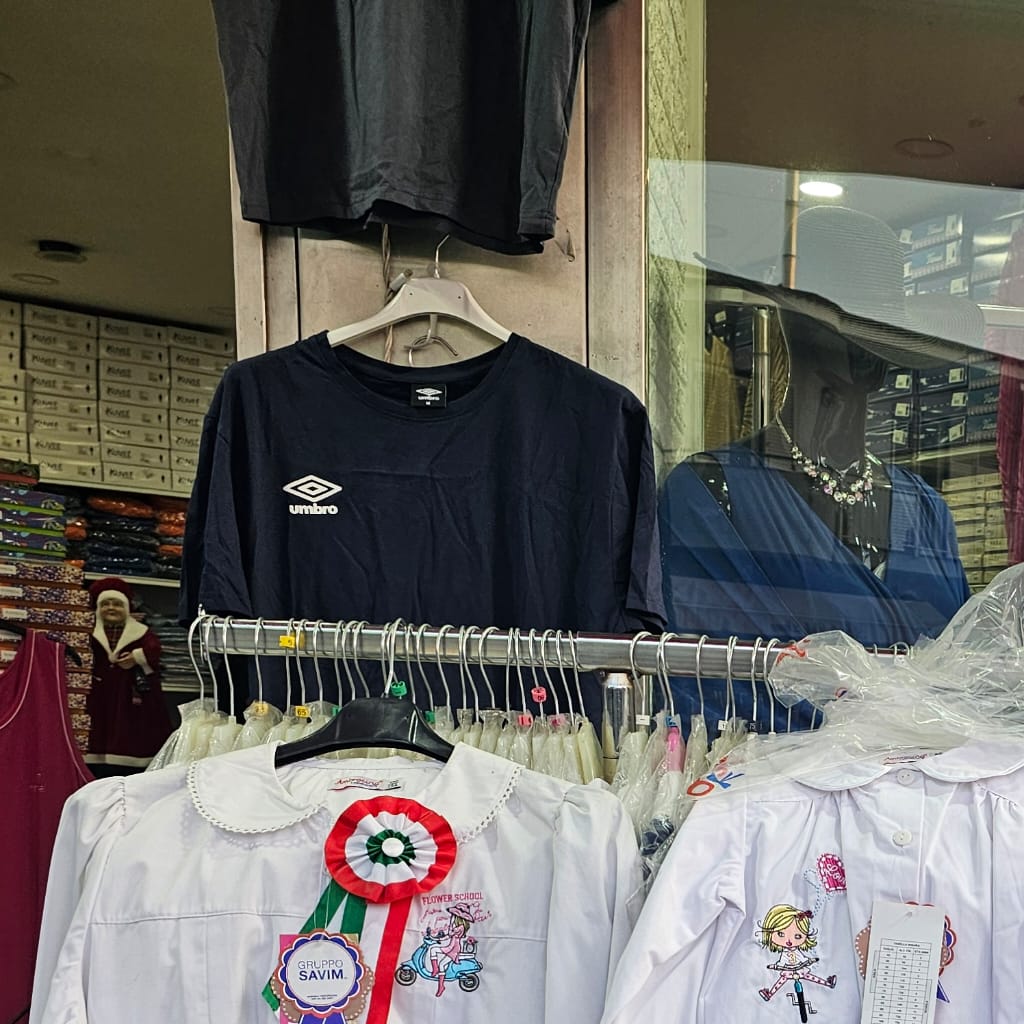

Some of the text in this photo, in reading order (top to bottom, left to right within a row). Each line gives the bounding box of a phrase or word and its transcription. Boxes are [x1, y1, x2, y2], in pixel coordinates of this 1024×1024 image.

[289, 502, 339, 515] umbro
[421, 891, 484, 906] FLOWER SCHOOL
[298, 959, 344, 970] GRUPPO
[298, 969, 344, 981] SAVIM
